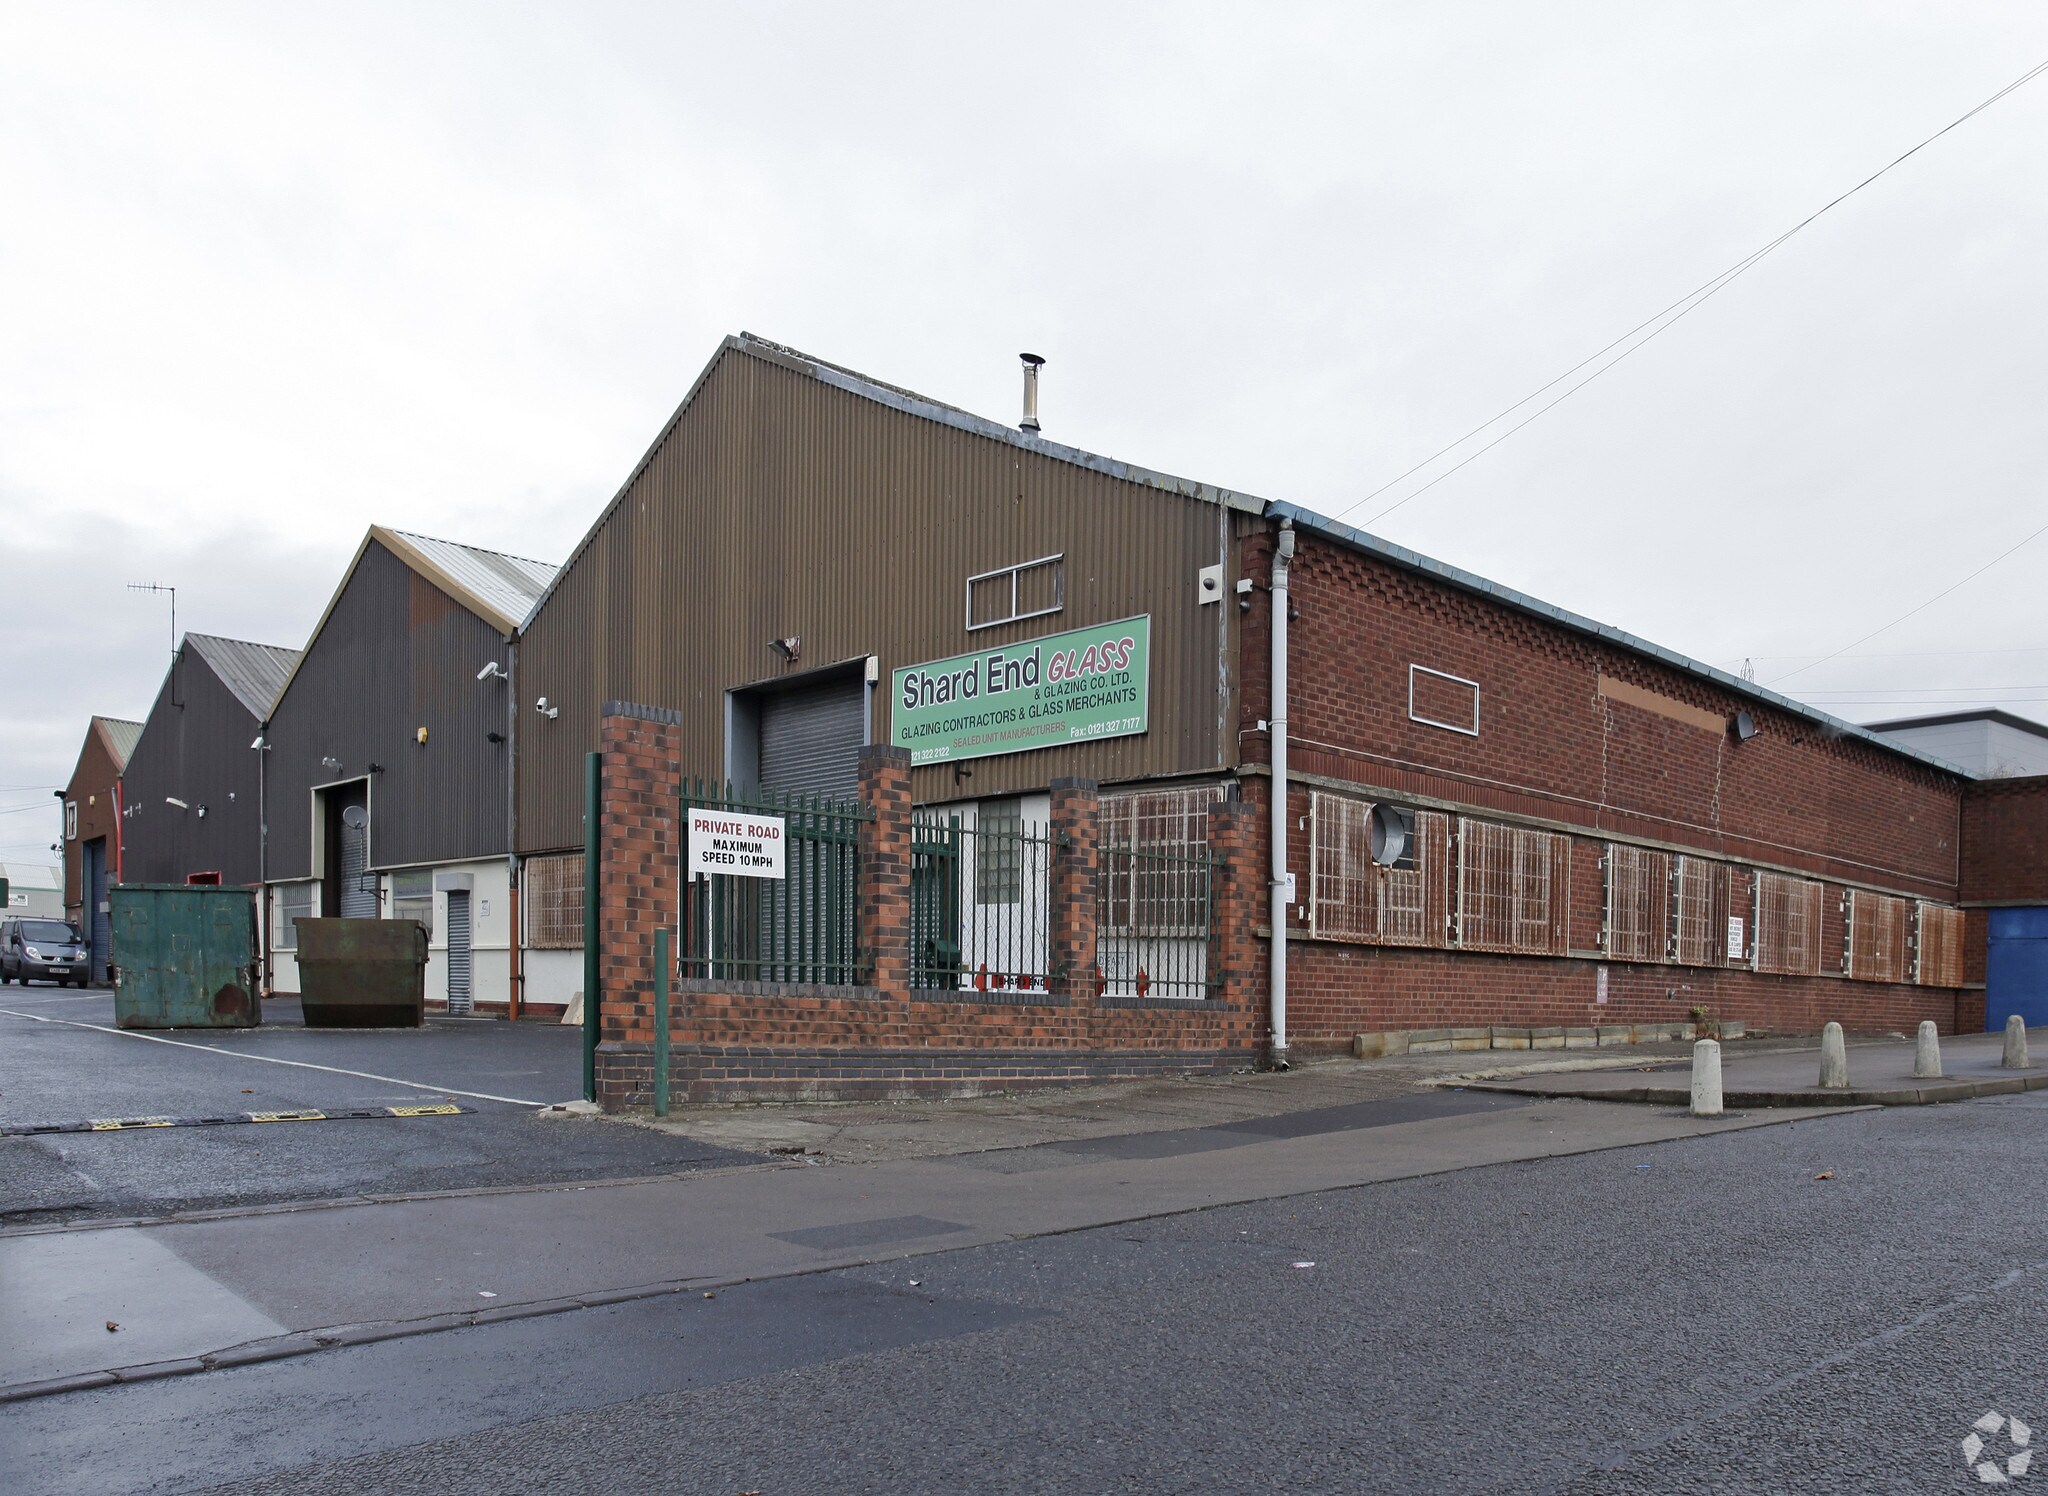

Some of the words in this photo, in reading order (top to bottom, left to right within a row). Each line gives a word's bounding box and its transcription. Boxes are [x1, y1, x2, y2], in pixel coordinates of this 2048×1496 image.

[902, 659, 979, 710] Shard
[987, 646, 1040, 694] End
[1048, 638, 1134, 682] GLASS
[1034, 688, 1040, 700] &
[1044, 679, 1087, 698] GLAZING
[1090, 676, 1108, 690] CO.
[1111, 672, 1132, 686] LTD.
[901, 721, 941, 739] GLAZING
[943, 708, 1016, 733] CONTRACTORS
[1019, 707, 1025, 720] &
[1028, 700, 1063, 718] GLASS
[1066, 687, 1137, 712] MERCHANTS
[953, 735, 980, 748] SEALED
[982, 732, 999, 744] UNIT
[1000, 721, 1066, 741] MANUFACTURERS
[1070, 727, 1087, 738] Fax:
[1088, 722, 1104, 734] 0121
[1106, 719, 1120, 731] 327
[1122, 717, 1141, 730] 7177
[921, 749, 933, 760] 322
[934, 746, 950, 758] 2122
[694, 819, 743, 836] PRIVATE
[748, 824, 780, 839] ROAD
[713, 839, 762, 853] MAXIMUM
[702, 851, 735, 864] SPEED
